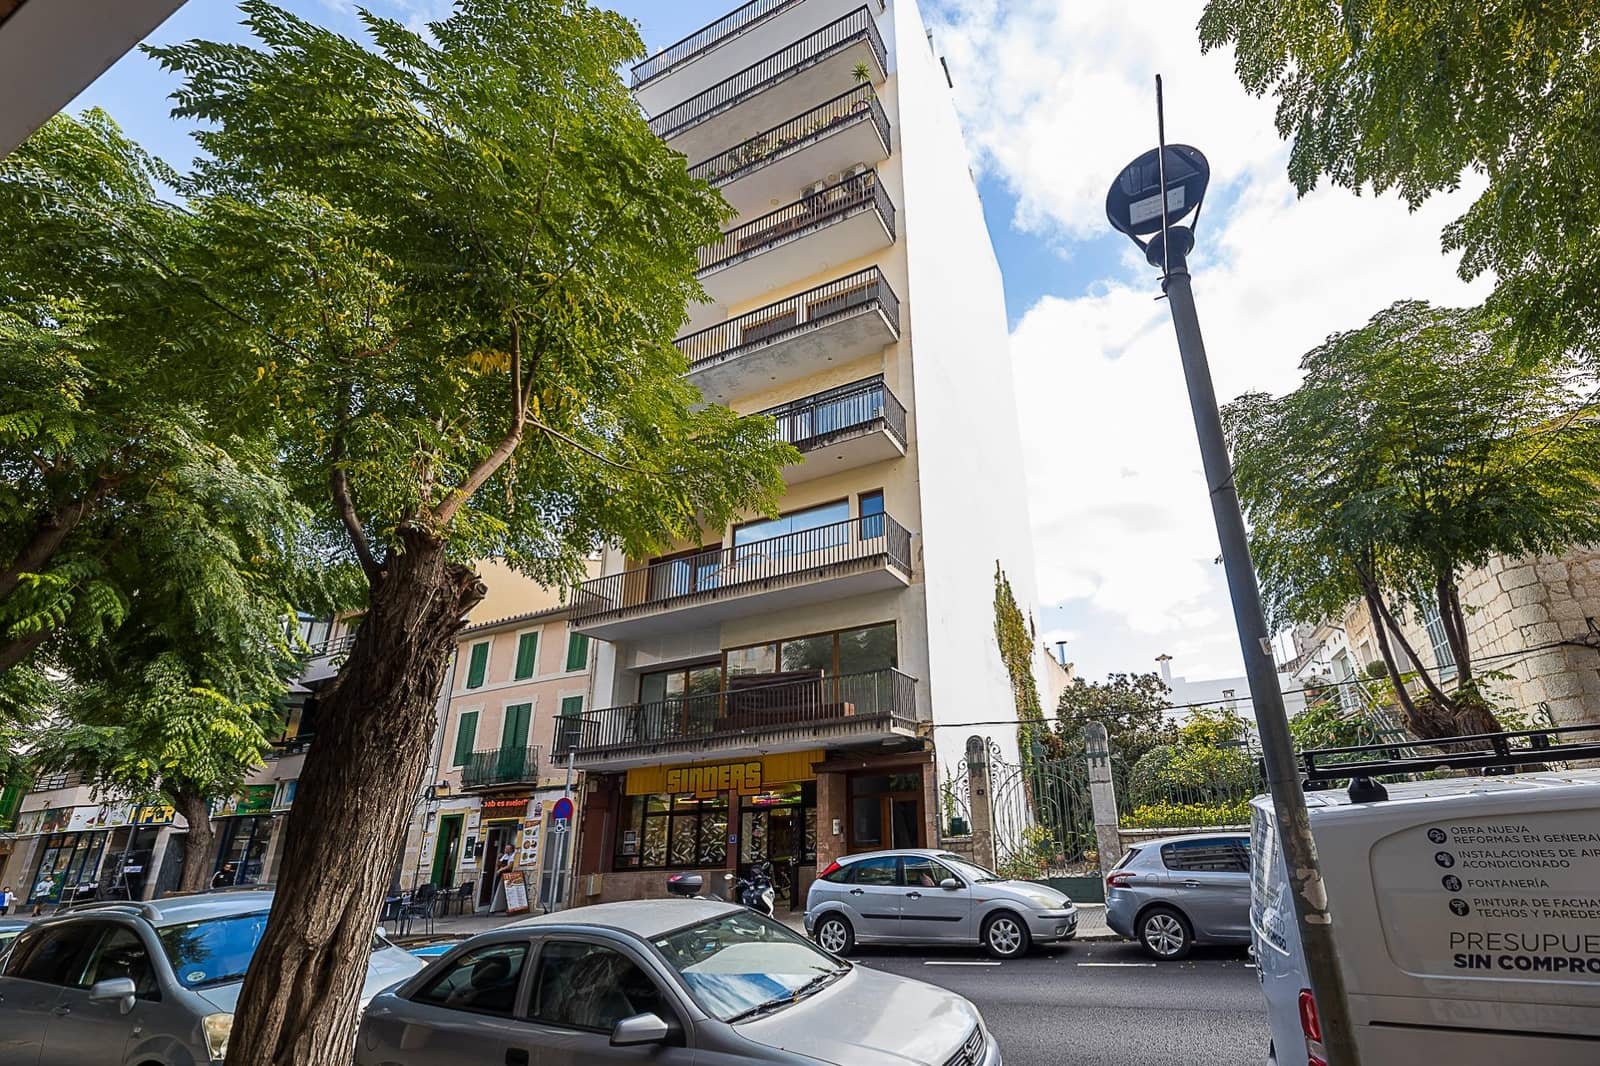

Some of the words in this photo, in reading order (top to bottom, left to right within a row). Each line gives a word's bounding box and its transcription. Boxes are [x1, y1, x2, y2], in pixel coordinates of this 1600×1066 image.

[667, 762, 763, 799] SINNERS
[1451, 826, 1484, 836] OBRA
[1487, 825, 1530, 835] NUEVA
[1453, 834, 1519, 845] REFORMAS
[1523, 834, 1541, 843] EN
[1458, 849, 1556, 859] INSTALACIONES
[1559, 849, 1579, 858] DE
[1462, 859, 1571, 869] ACONDICIONADO
[1467, 877, 1550, 889] FONTANERÍA
[1473, 898, 1530, 908] PINTURA
[1532, 898, 1550, 908] DE
[1477, 908, 1529, 919] TECHOS
[1531, 909, 1539, 918] Y
[1454, 953, 1492, 970] SIN
[1497, 954, 1600, 975] COMPRO
